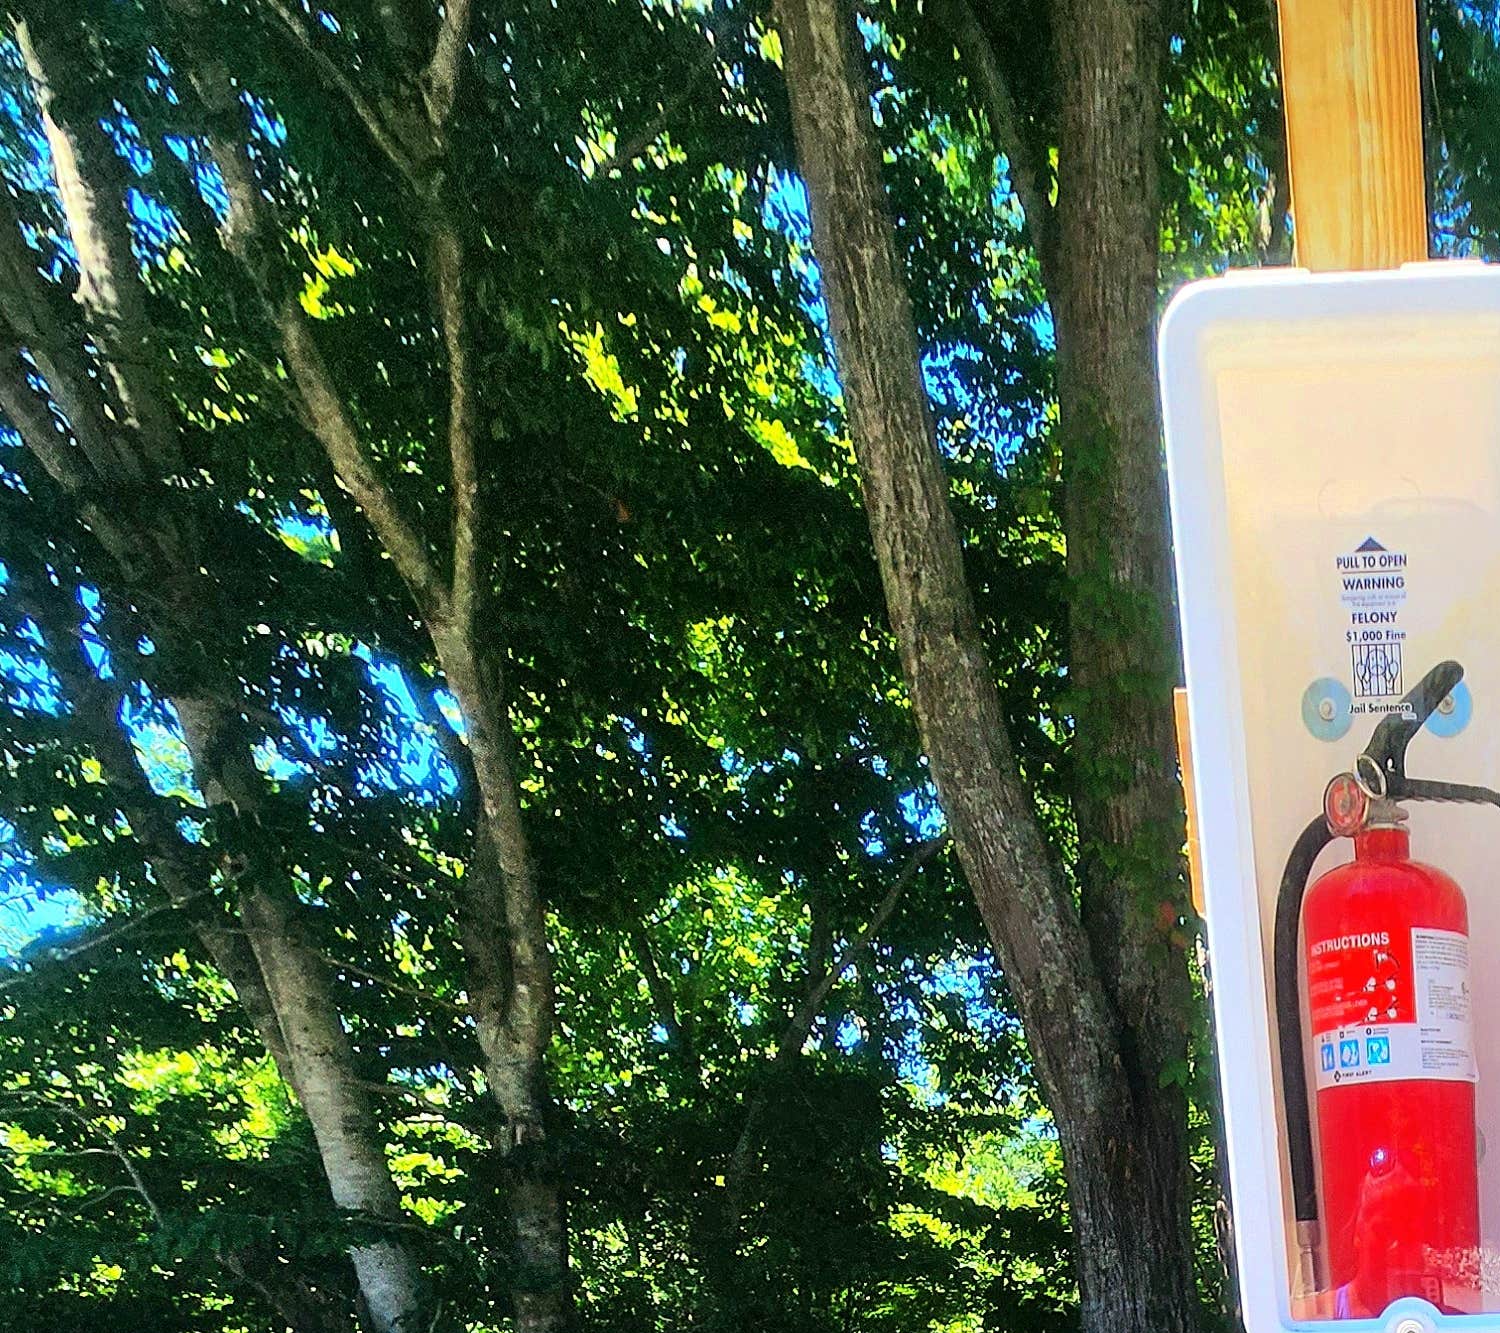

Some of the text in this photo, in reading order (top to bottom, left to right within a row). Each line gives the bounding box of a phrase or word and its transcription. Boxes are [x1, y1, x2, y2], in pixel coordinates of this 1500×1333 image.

[1336, 554, 1408, 570] PULL TO OPEN
[1343, 576, 1405, 591] WARNING
[1352, 611, 1398, 625] FELONY
[1346, 630, 1407, 643] $1,000 Fine
[1349, 702, 1411, 715] Jail Sentence
